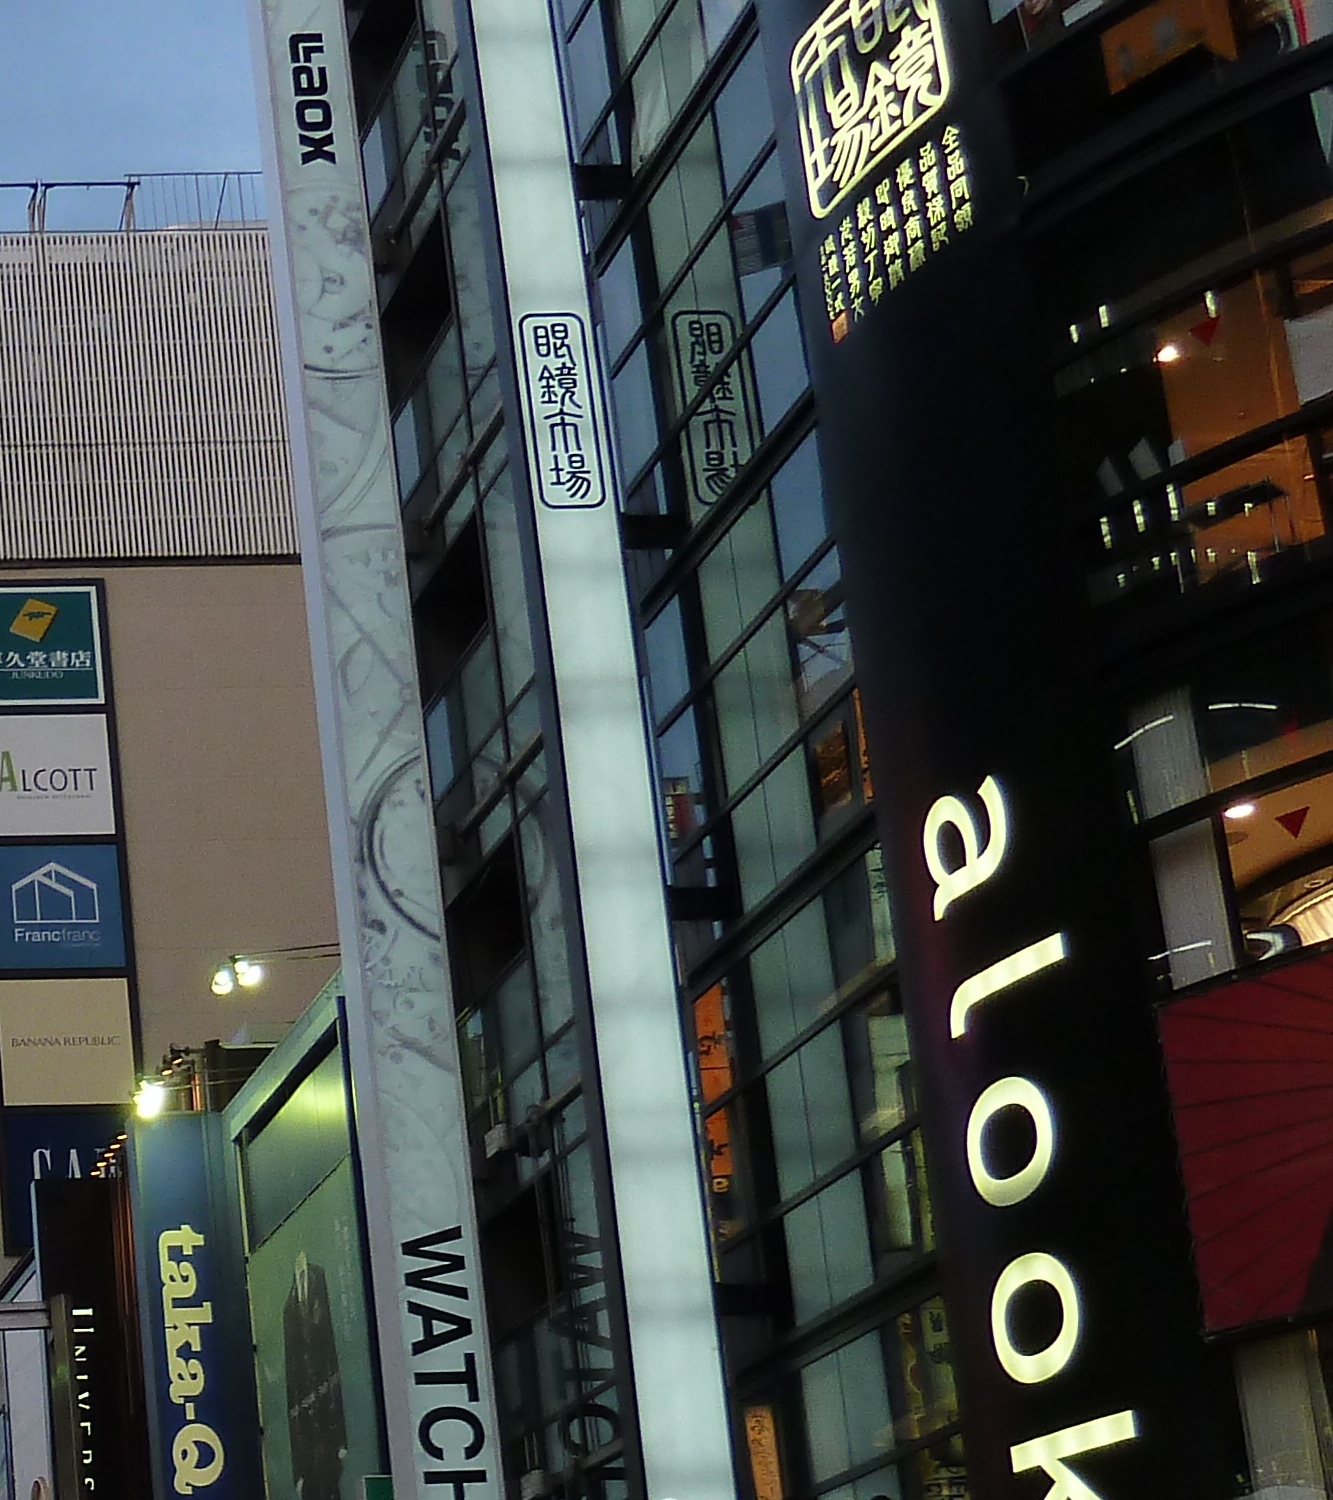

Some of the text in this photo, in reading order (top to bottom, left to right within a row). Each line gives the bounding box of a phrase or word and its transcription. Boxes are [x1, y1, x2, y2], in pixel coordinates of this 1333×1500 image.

[533, 322, 593, 501] 眼鏡市場
[14, 927, 101, 944] Francfranc
[10, 1035, 121, 1049] BANANA REPUBLIC
[157, 1224, 226, 1496] taka-Q
